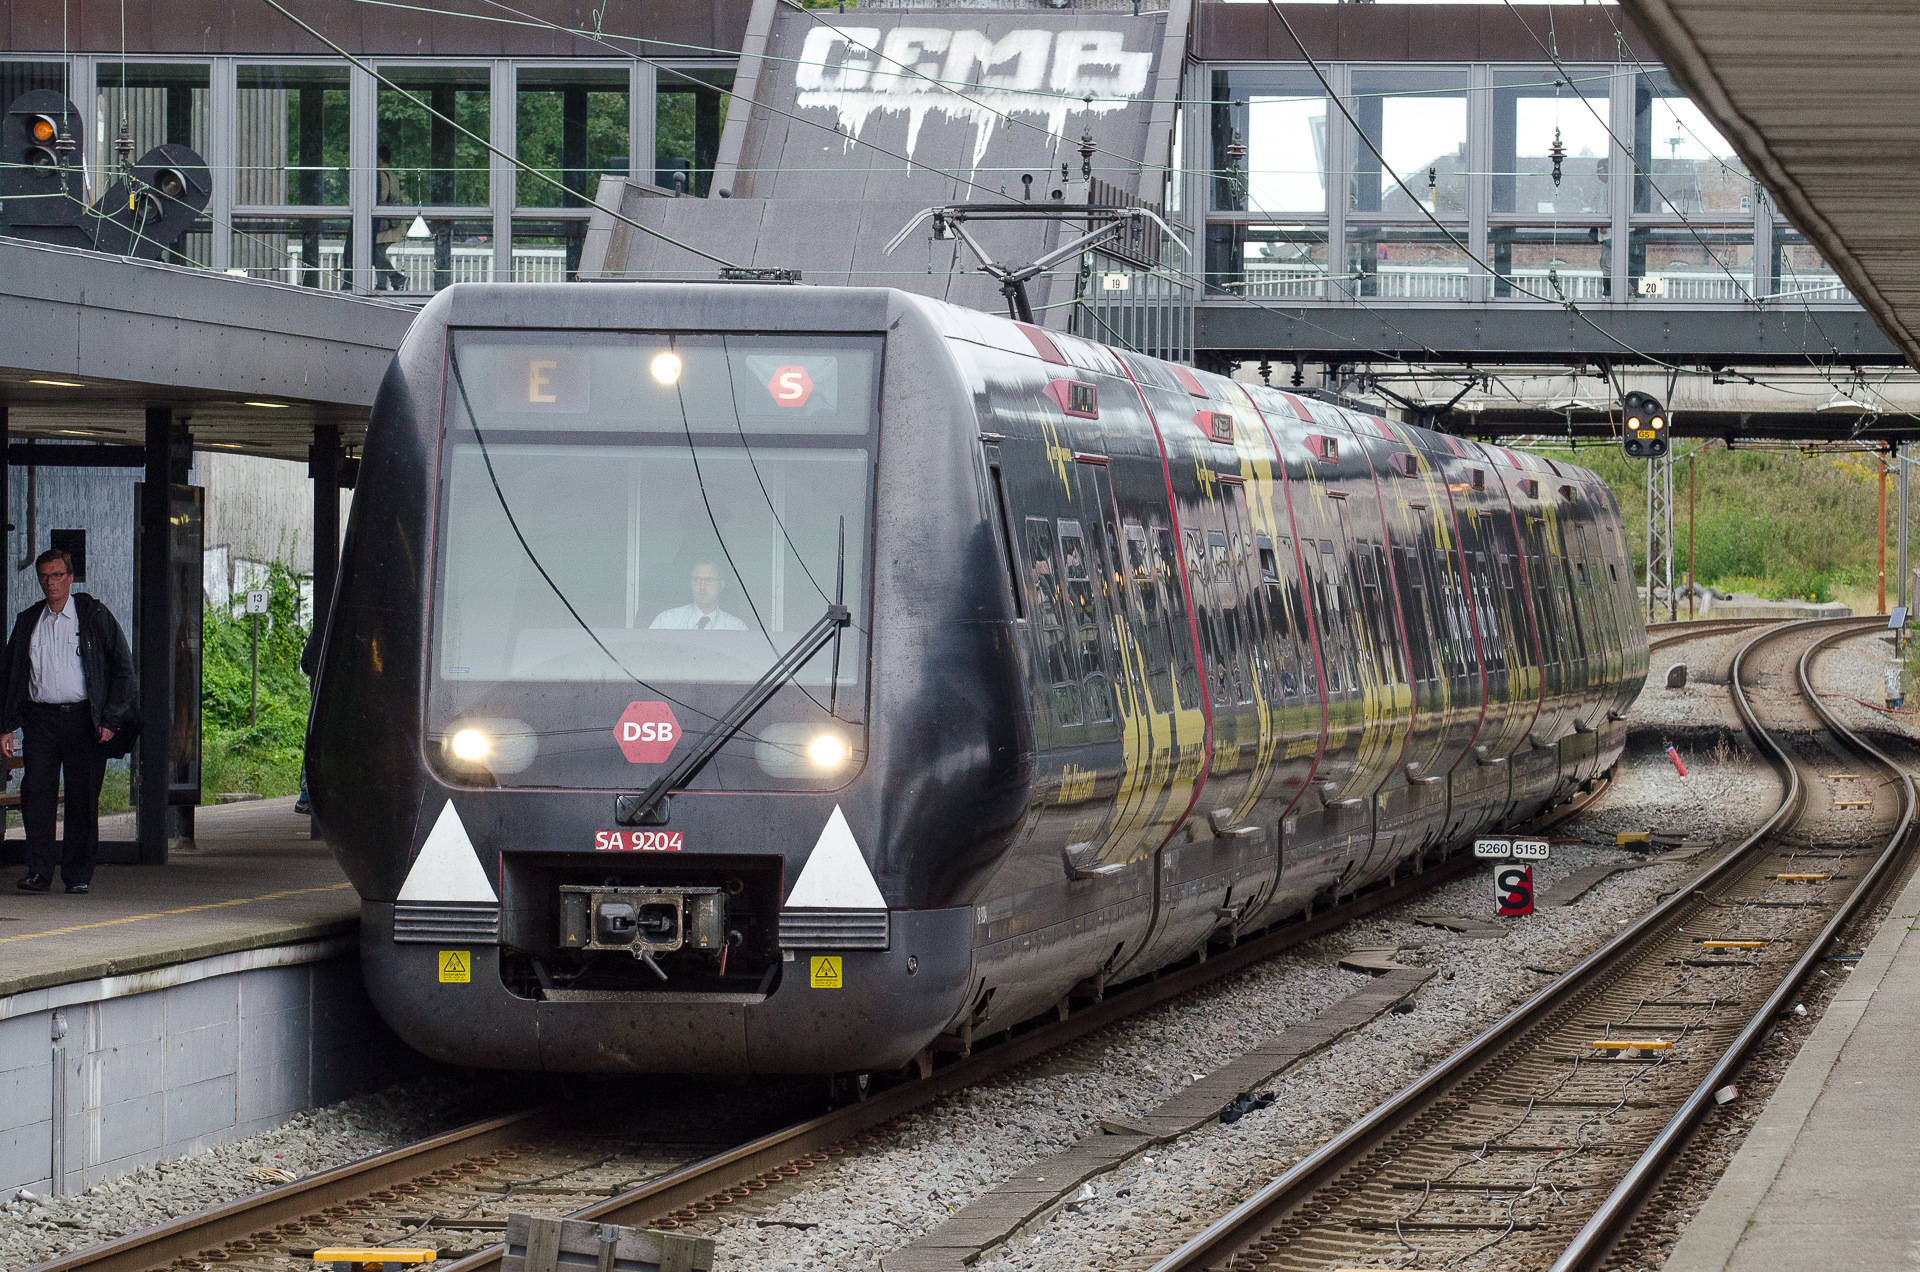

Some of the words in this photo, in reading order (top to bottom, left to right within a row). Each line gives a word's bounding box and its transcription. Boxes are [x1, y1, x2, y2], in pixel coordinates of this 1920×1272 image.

[1112, 279, 1120, 289] 19
[1646, 283, 1657, 293] 20
[529, 361, 557, 403] E
[778, 372, 804, 400] S
[253, 594, 263, 603] 13
[623, 722, 674, 742] DSB
[595, 831, 624, 851] SA
[631, 832, 682, 851] 9204
[1478, 843, 1508, 854] 5260
[1515, 844, 1547, 856] 5158
[1497, 869, 1531, 910] S
